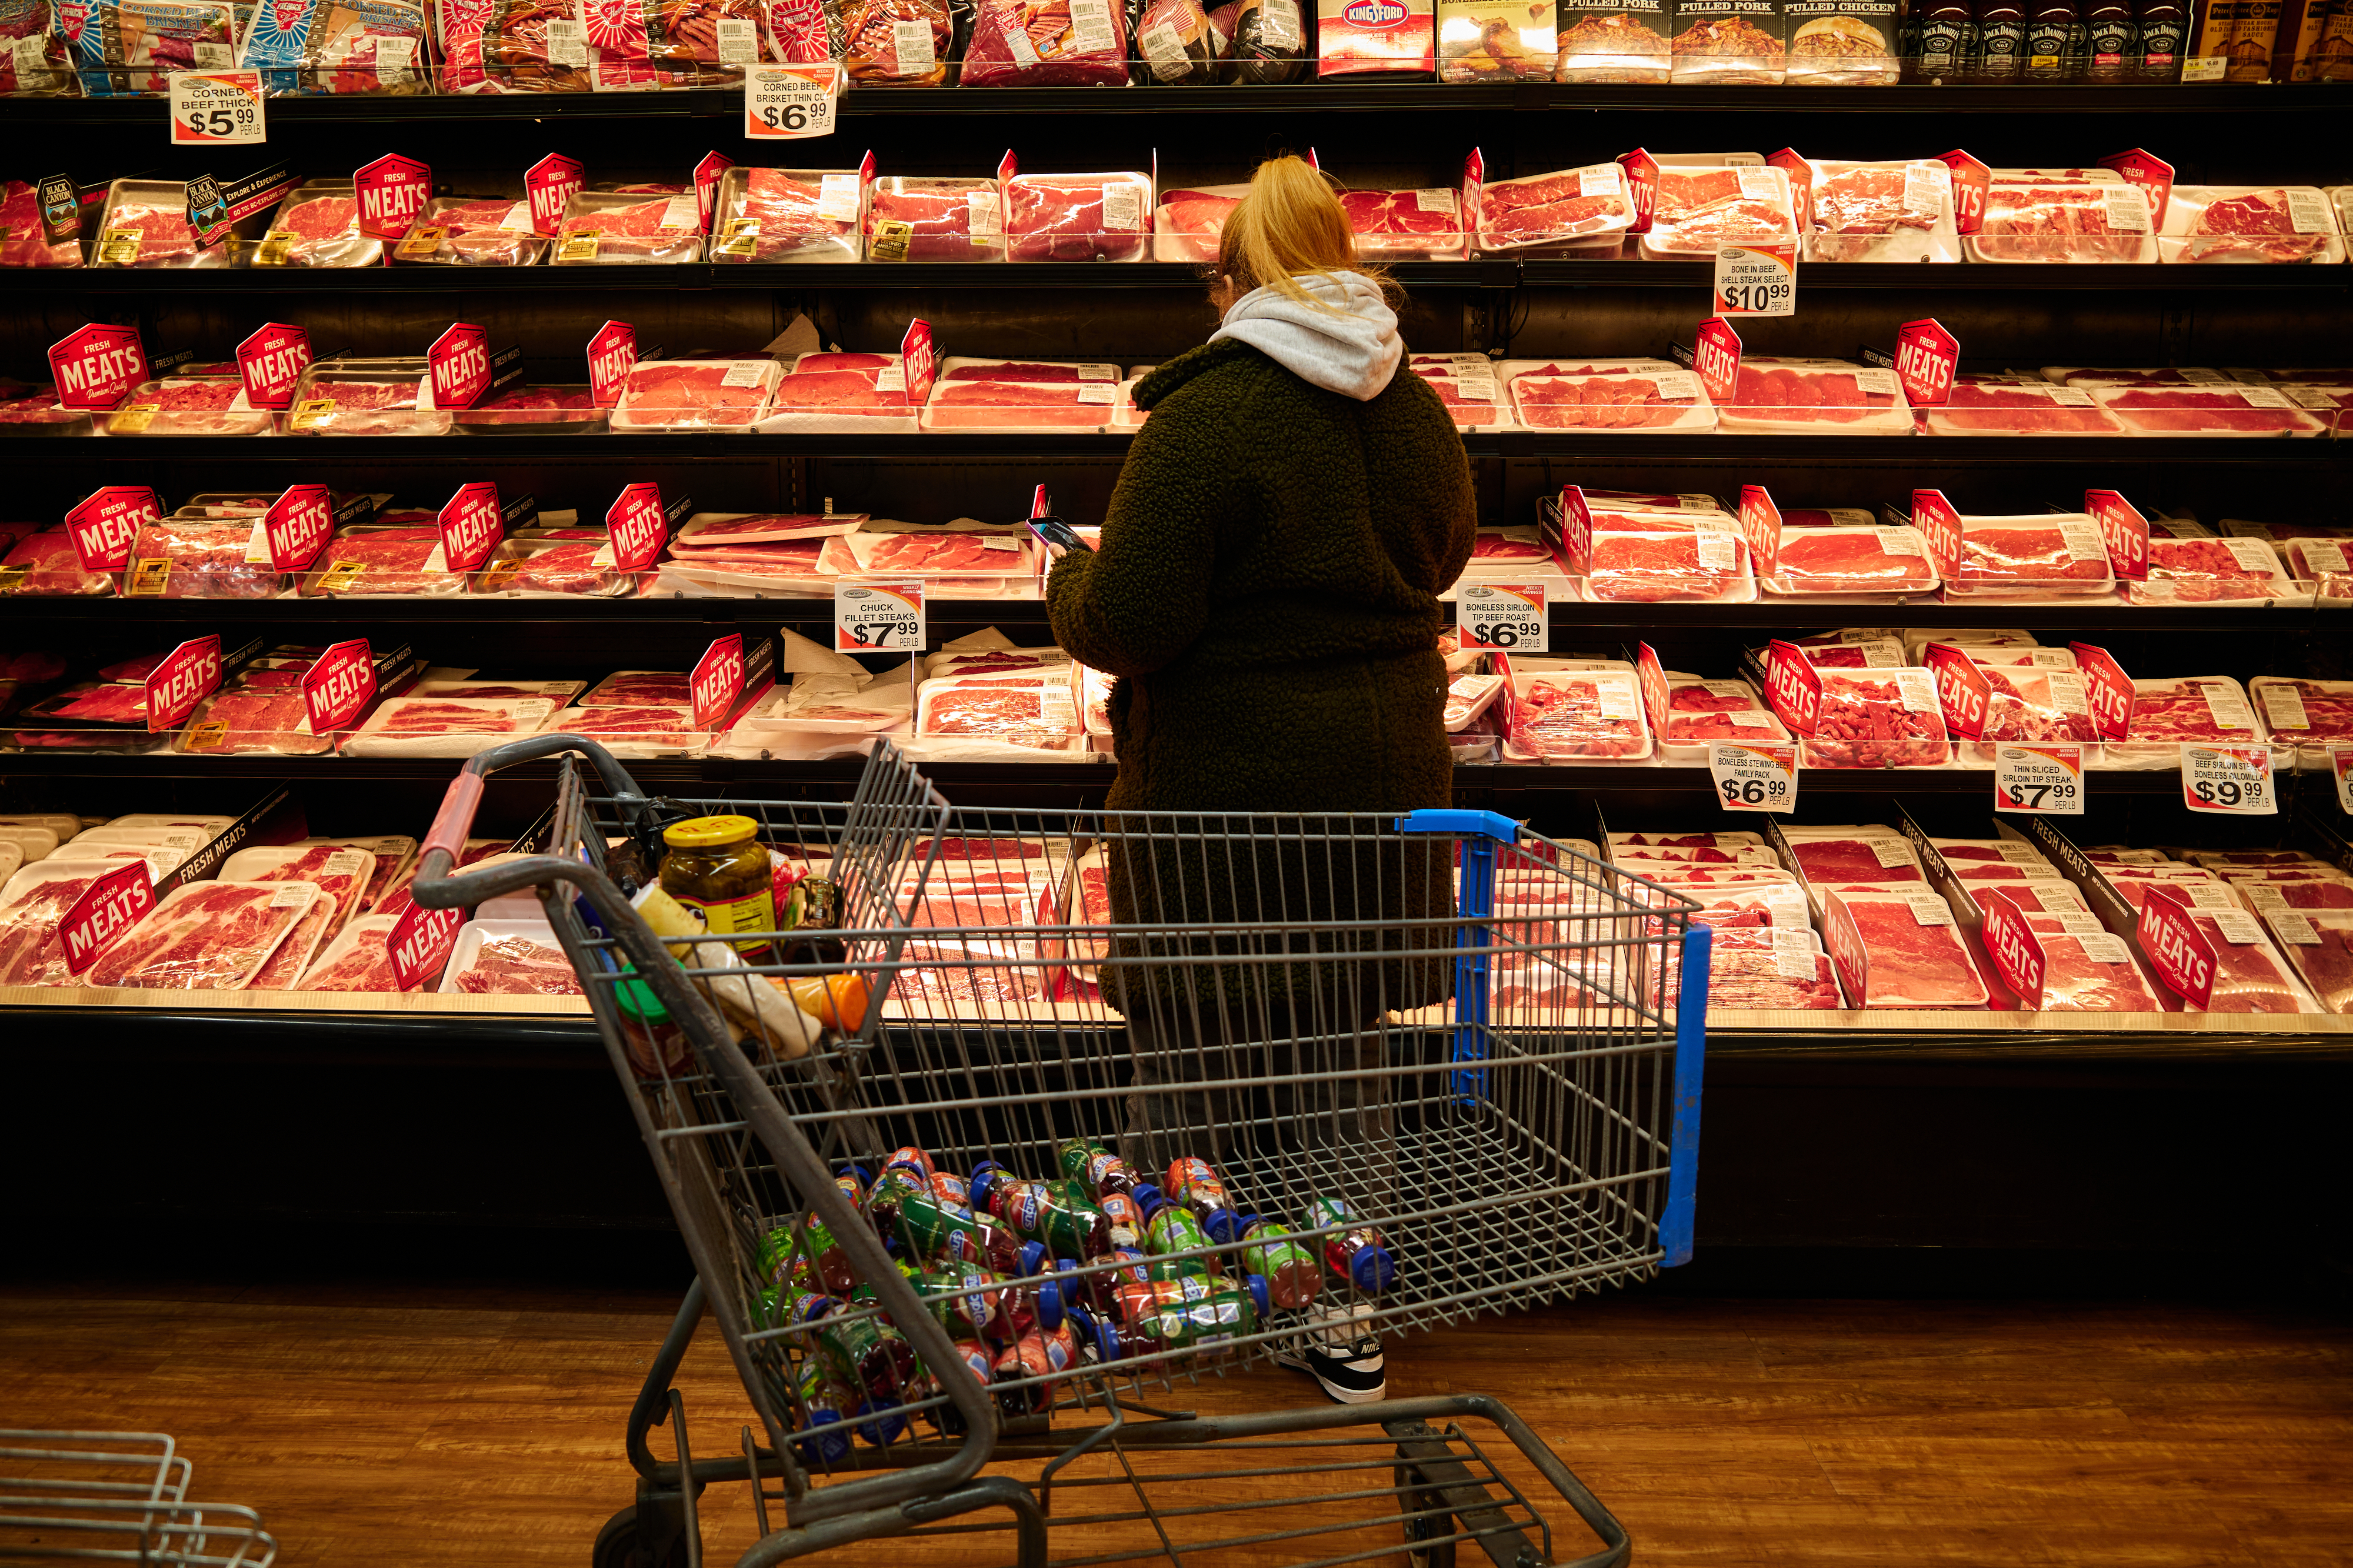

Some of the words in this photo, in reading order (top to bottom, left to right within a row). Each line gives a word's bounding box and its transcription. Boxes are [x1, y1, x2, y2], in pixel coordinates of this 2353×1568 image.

[122, 4, 181, 16] CORNED
[1680, 2, 1731, 11] PULLED
[1734, 3, 1772, 12] PORK
[1785, 4, 1835, 12] PULLED
[1839, 4, 1896, 12] CHICKEN
[784, 13, 810, 25] FREIRICH
[1349, 6, 1403, 24] KINGSFORD
[145, 15, 202, 31] BRISKET
[1922, 28, 1935, 39] JACK
[2029, 30, 2044, 41] JACK
[193, 88, 244, 97] CORNED
[756, 94, 791, 102] BRISKET
[182, 101, 214, 109] BEEF
[218, 98, 255, 107] THICK
[241, 125, 252, 135] PER
[254, 124, 261, 134] LB
[812, 118, 824, 129] PER
[824, 117, 831, 127] LB
[384, 172, 406, 182] FRESH
[189, 181, 213, 196] BLACK
[191, 189, 218, 207] CANYON
[250, 187, 289, 209] BC-EXPLORE.COM
[363, 184, 427, 219] MEATS
[205, 229, 219, 242] ANGUS
[1771, 302, 1782, 311] PER
[1783, 302, 1788, 311] LB
[84, 340, 111, 353] FRESH
[451, 339, 468, 353] FRESH
[1712, 332, 1725, 346] FRESH
[1919, 336, 1937, 349] FRESH
[61, 346, 140, 393] MEATS
[435, 345, 486, 393] MEATS
[1696, 339, 1735, 385] MEATS
[1897, 342, 1950, 389] MEATS
[288, 499, 306, 515] FRESH
[461, 499, 478, 515] FRESH
[273, 503, 328, 557] MEATS
[446, 502, 497, 558] MEATS
[1565, 505, 1589, 559] MEATS
[900, 638, 910, 646] PER
[912, 638, 918, 646] LB
[1521, 639, 1532, 648] PER
[1534, 639, 1540, 648] LB
[175, 653, 196, 673] FRESH
[328, 656, 348, 675] FRESH
[711, 652, 726, 670] FRESH
[1787, 658, 1802, 677] FRESH
[154, 652, 216, 716] MEATS
[311, 656, 369, 718] MEATS
[696, 651, 739, 713] MEATS
[1768, 658, 1815, 719] MEATS
[1718, 758, 1748, 766] BONELESS
[1749, 759, 1774, 768] STEWING
[2212, 761, 2238, 769] SIRLOIN
[1734, 769, 1753, 778] FAMILY
[1755, 770, 1769, 779] PACK
[2194, 770, 2228, 779] BONELESS
[2229, 773, 2264, 781] PALOMILLA
[1769, 796, 1780, 805] PER
[1782, 797, 1789, 805] LB
[2055, 801, 2067, 809] PER
[2068, 801, 2075, 810] LB
[2248, 798, 2259, 806] PER
[2261, 798, 2269, 807] LB
[180, 853, 215, 884] FRESH
[215, 822, 247, 855] MEATS
[92, 885, 118, 909] FRESH
[68, 878, 148, 959] MEATS
[2006, 915, 2024, 938] FRESH
[2169, 914, 2191, 940] FRESH
[1987, 906, 2039, 989] MEATS
[2143, 905, 2208, 989] MEATS
[1361, 1342, 1379, 1354] NIKE
